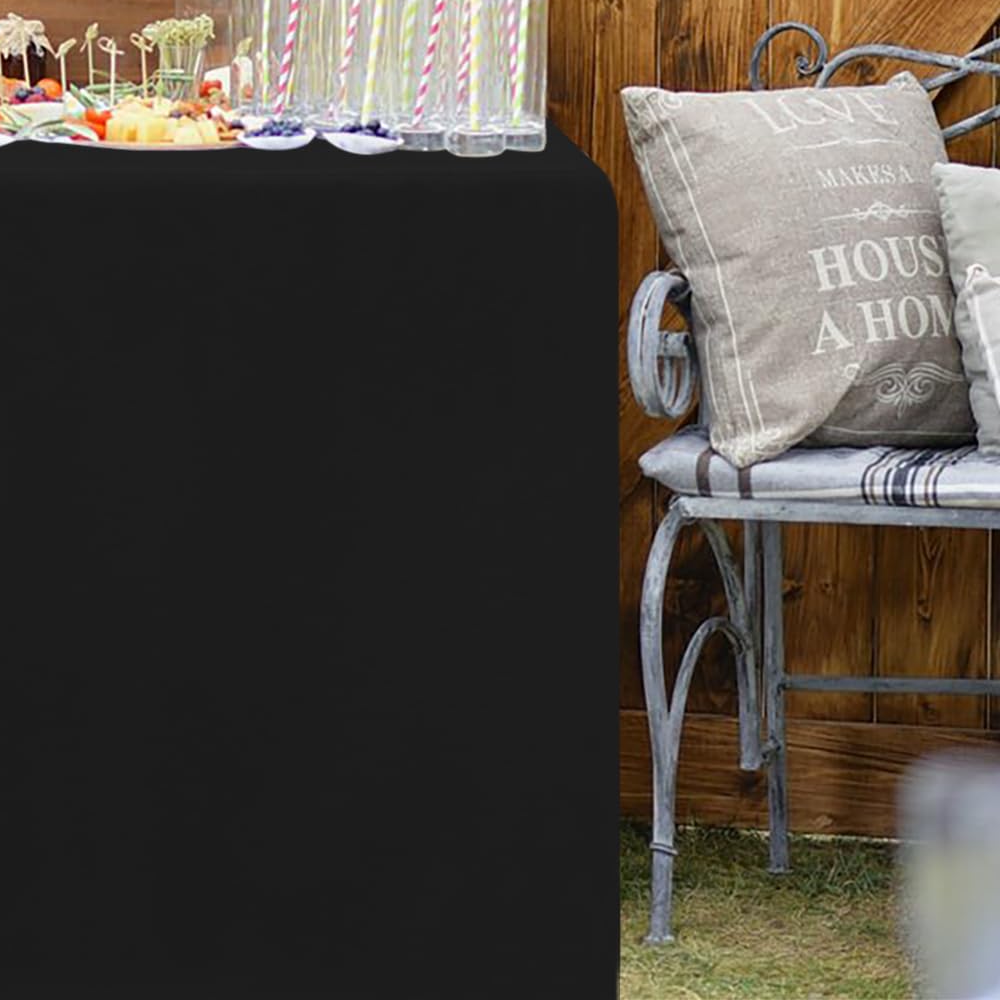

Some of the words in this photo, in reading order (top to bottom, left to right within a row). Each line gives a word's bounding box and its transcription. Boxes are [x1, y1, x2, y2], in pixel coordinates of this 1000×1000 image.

[816, 163, 896, 188] MAKES
[808, 235, 948, 292] HOUS
[811, 309, 854, 355] A
[857, 294, 951, 343] HOM
